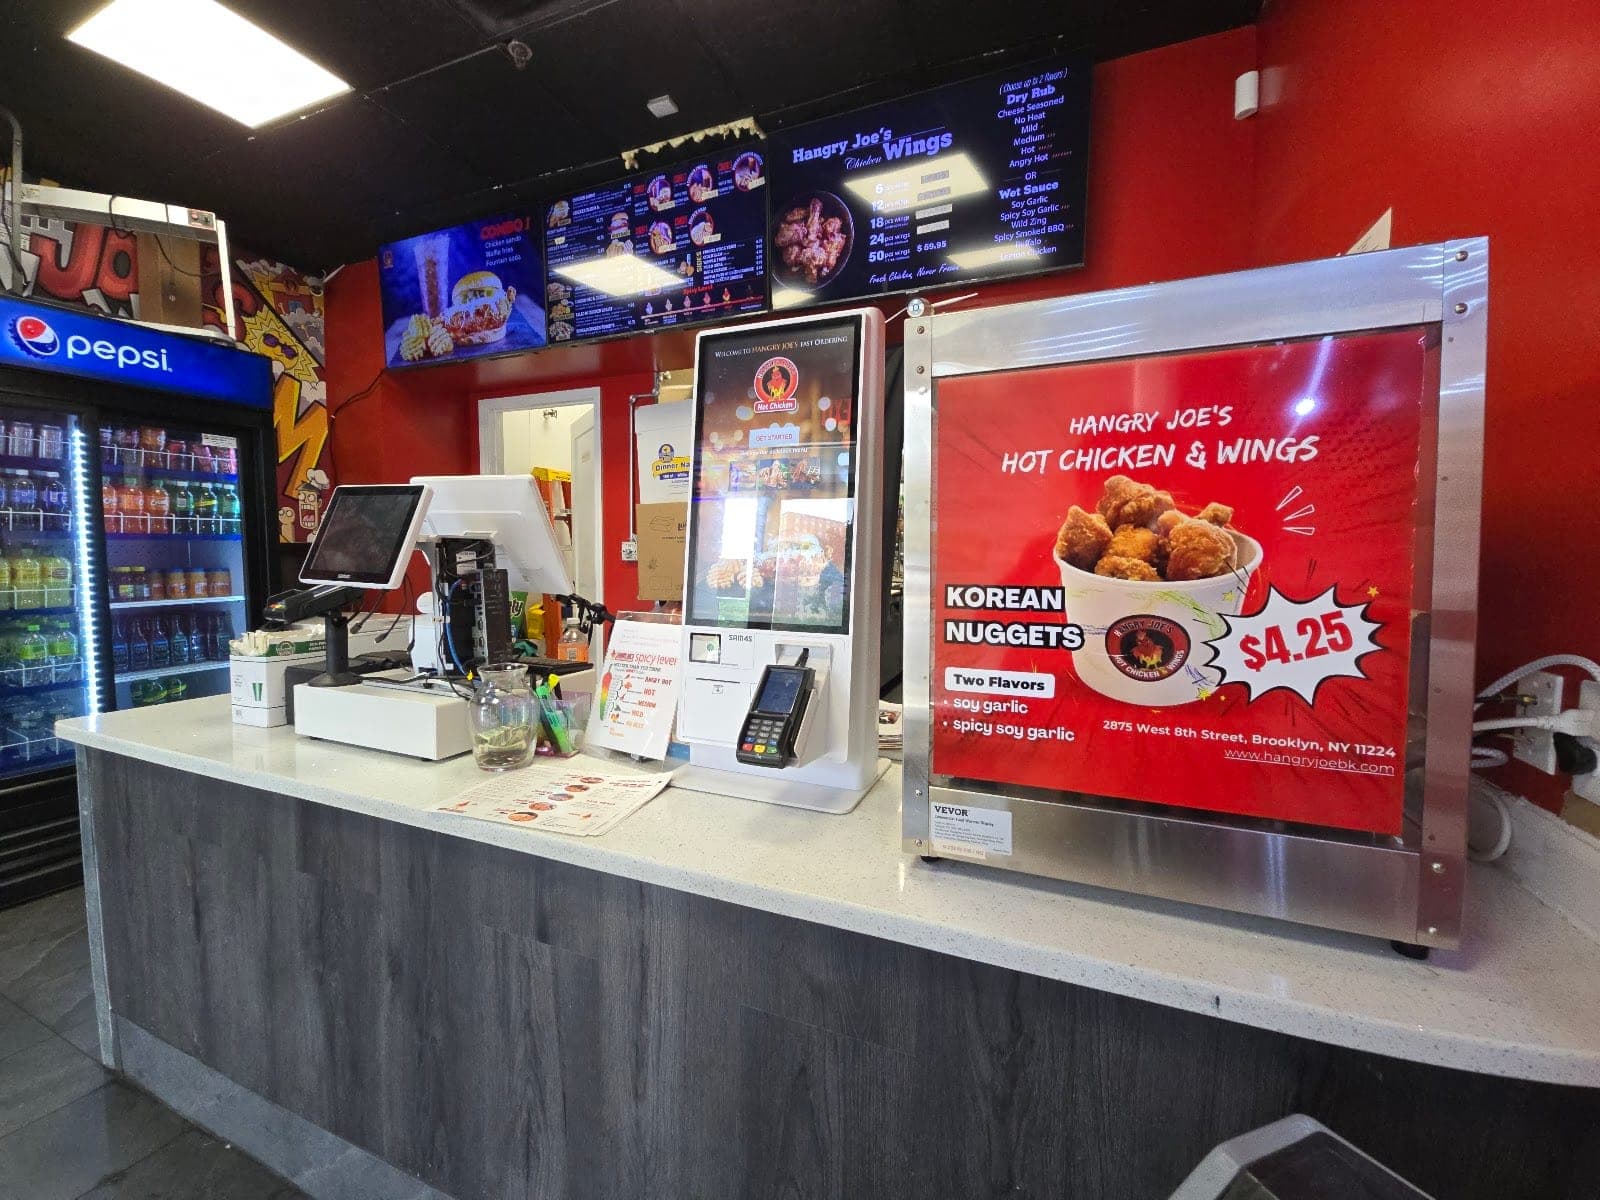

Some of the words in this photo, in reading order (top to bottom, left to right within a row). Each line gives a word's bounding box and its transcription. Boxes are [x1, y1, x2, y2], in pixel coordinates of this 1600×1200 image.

[1006, 92, 1028, 105] Dry
[1032, 84, 1055, 99] Rub
[997, 106, 1025, 118] Cheese
[1026, 96, 1065, 111] Seasoned
[1014, 117, 1026, 125] No
[1028, 112, 1046, 122] Heat
[1021, 122, 1038, 134] Mild
[792, 140, 848, 163] Hangry
[852, 128, 892, 149] Joe's
[1013, 134, 1045, 146] Medium
[844, 155, 882, 170] Chicken
[882, 132, 953, 161] Wings
[1021, 146, 1035, 155] Hot
[1009, 156, 1032, 168] Angry
[1034, 153, 1049, 163] Hot
[1025, 171, 1037, 180] OR
[998, 188, 1021, 199] Wet
[1024, 182, 1059, 195] Sauce
[1011, 200, 1026, 209] Soy
[1026, 195, 1048, 206] Garlic
[1000, 211, 1020, 221] Spicy
[1022, 209, 1036, 217] Soy
[1037, 204, 1059, 214] Garlic
[870, 217, 884, 229] 18
[1011, 219, 1028, 229] Wild
[1030, 217, 1047, 226] Zing
[870, 233, 884, 246] 24
[994, 233, 1014, 243] Spicy
[1016, 227, 1046, 238] Smoked
[1048, 223, 1064, 232] BBQ
[868, 250, 884, 262] 50
[916, 267, 936, 278] Never
[752, 343, 780, 353] HANGRY
[800, 340, 813, 348] FAST
[815, 336, 848, 346] ORDERING
[66, 335, 168, 372] pepsi
[757, 402, 769, 411] Hot
[770, 401, 793, 409] Chicken
[1069, 411, 1158, 436] HANGRY
[1166, 405, 1233, 430] JOE'S
[1001, 450, 1052, 474] HOT
[1059, 444, 1176, 472] CHICKEN
[1185, 441, 1207, 470] &
[1216, 434, 1320, 466] WINGS
[656, 463, 678, 471] Dinner
[946, 586, 1063, 610] KOREAN
[945, 622, 1083, 649] NUGGETS
[1113, 620, 1145, 638] HANGRY
[1147, 620, 1174, 634] JOE'S
[1239, 610, 1353, 672] $4.25
[1113, 654, 1127, 668] HOT
[1126, 665, 1160, 678] CHICKEN
[1166, 650, 1184, 670] WINGS
[954, 674, 984, 686] Two
[989, 677, 1045, 690] Flavors
[644, 688, 656, 696] HOT
[954, 698, 980, 712] soy
[983, 700, 1029, 714] garlic
[953, 718, 992, 736] spicy
[996, 724, 1024, 739] soy
[1028, 727, 1075, 742] garlic
[1103, 720, 1133, 732] 2875
[1136, 723, 1171, 736] West
[1174, 727, 1197, 739] 8th
[1201, 729, 1248, 745] Street,
[1252, 734, 1323, 753] Brooklyn,
[1328, 742, 1350, 753] NY
[1355, 744, 1397, 758] 11224
[1224, 749, 1395, 775] www.hangryjoebk.com
[934, 806, 968, 816] VEVOR
